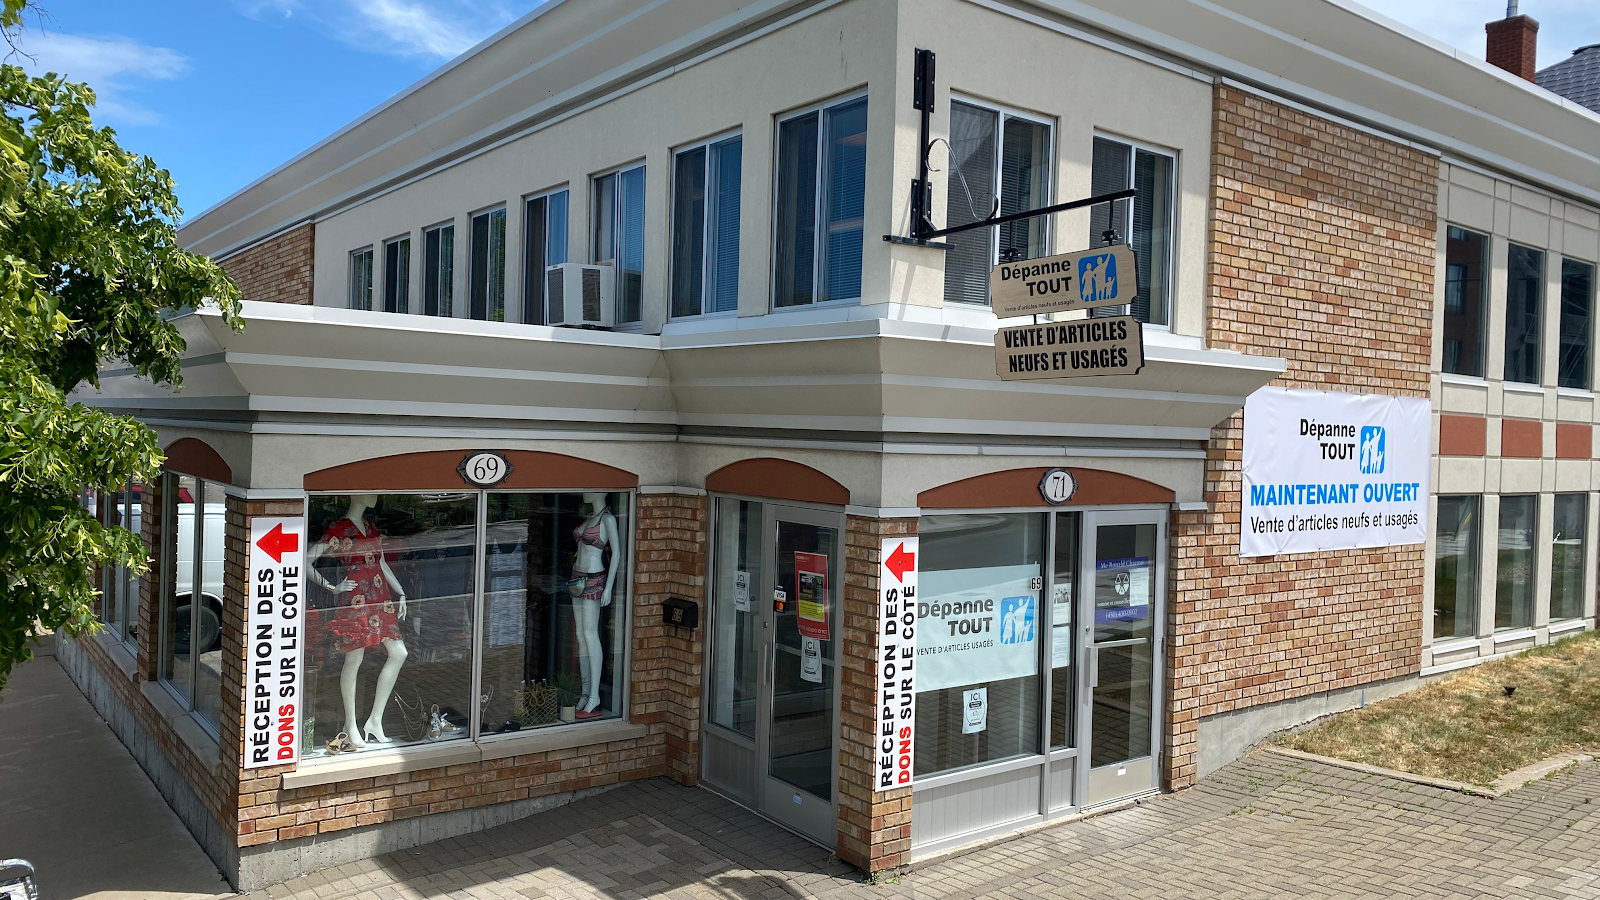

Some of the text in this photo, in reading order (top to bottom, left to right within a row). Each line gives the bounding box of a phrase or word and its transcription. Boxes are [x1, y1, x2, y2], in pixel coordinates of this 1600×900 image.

[1001, 260, 1071, 281] Dépanne
[1026, 276, 1072, 296] TOUT
[1003, 320, 1128, 348] VENTE D'ARTICLES
[1009, 344, 1128, 373] NEUFS ET USAGÉS
[1300, 418, 1356, 440] Dépanne
[1320, 442, 1356, 460] TOUT
[474, 457, 498, 480] 69
[1052, 475, 1066, 498] 71
[1251, 482, 1420, 506] MAINTENANT OUVERT
[1251, 516, 1284, 534] Vente
[1342, 511, 1370, 530] neufs
[1372, 512, 1383, 527] et
[1385, 509, 1418, 530] usagés
[1031, 577, 1041, 590] 69
[917, 598, 994, 620] Dépanne
[948, 617, 993, 637] TOUT
[916, 638, 994, 656] VENTE D'ARTICLES USAGÉS
[250, 568, 275, 763] RÉCEPTION DES
[277, 565, 299, 760] DONS SUR LE CÔTÉ
[879, 588, 898, 787] RÉCEPTION DES
[898, 585, 916, 784] DONS SUR LE CÔTÉ
[970, 692, 980, 701] ICI
